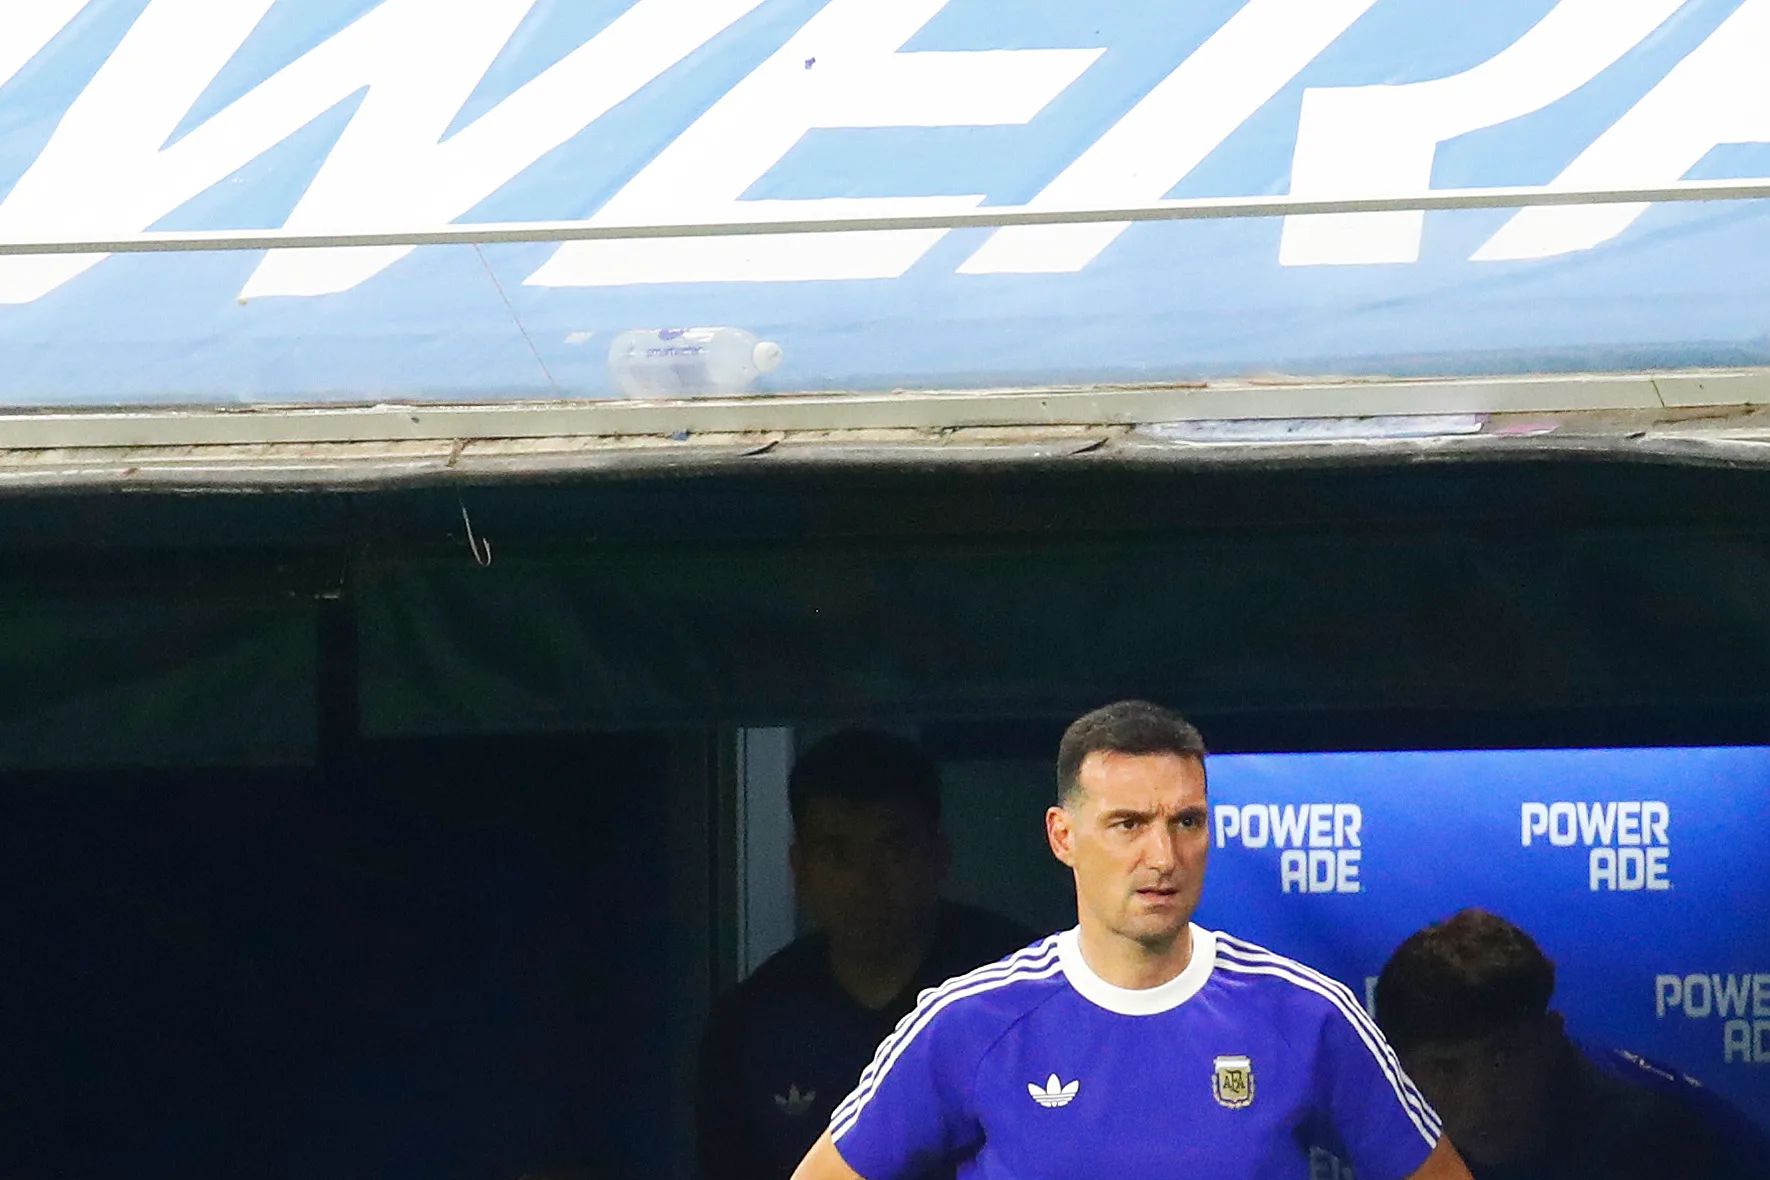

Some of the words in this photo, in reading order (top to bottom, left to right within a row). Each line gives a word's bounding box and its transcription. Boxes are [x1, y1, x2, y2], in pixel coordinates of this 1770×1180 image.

[1214, 803, 1363, 849] POWER
[1521, 801, 1670, 847] POWER
[1281, 848, 1362, 893] ADE
[1589, 847, 1670, 891] ADE
